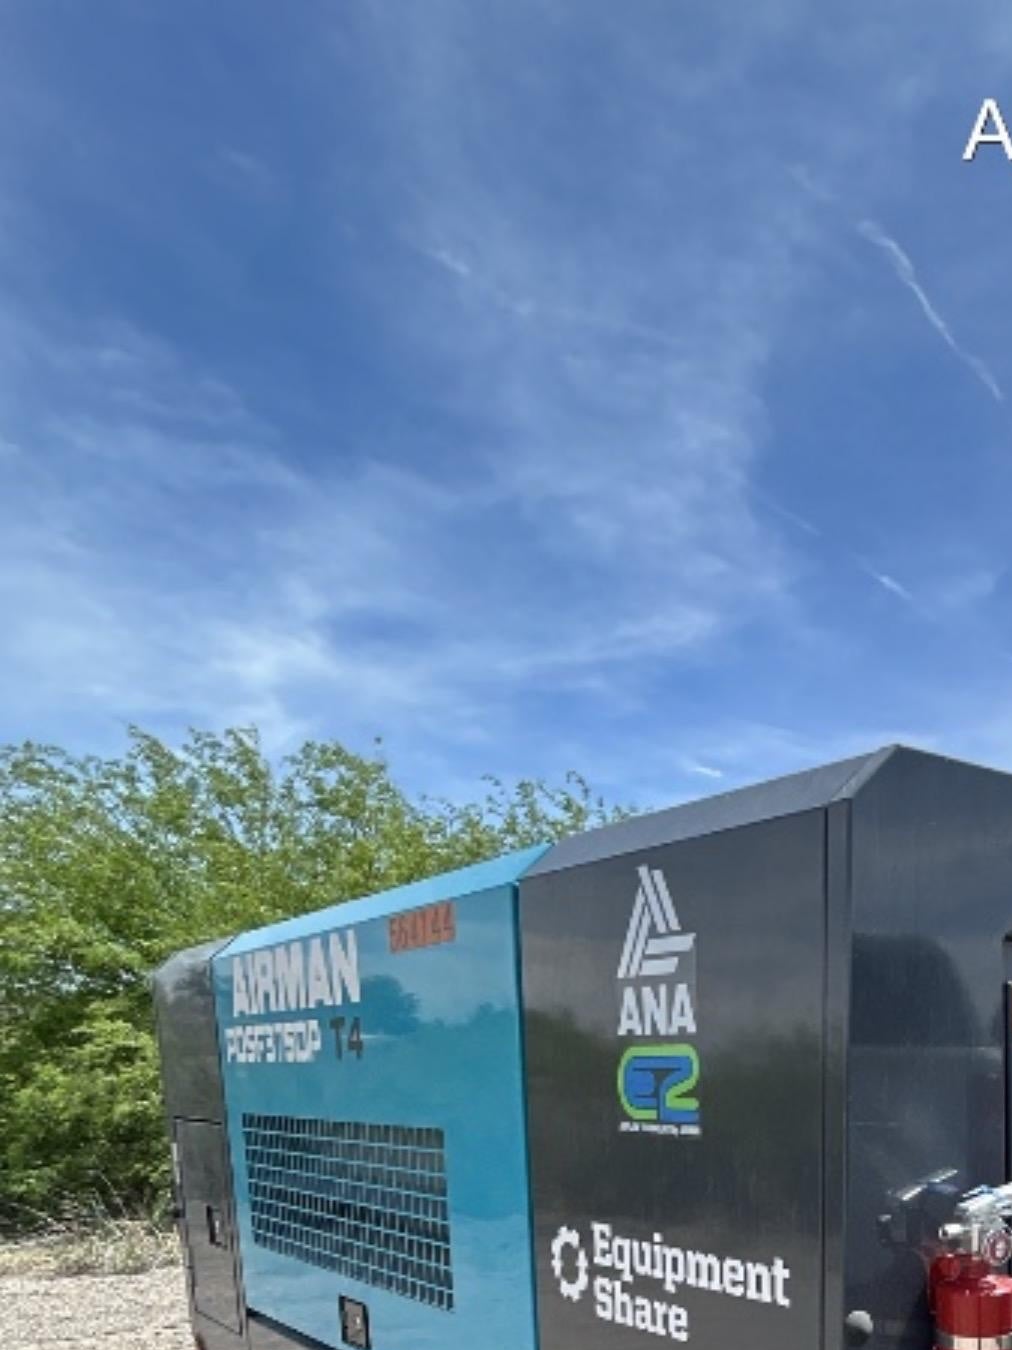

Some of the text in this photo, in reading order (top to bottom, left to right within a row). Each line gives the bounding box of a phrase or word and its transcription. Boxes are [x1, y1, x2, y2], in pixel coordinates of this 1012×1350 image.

[232, 929, 361, 1018] AIRMAN
[329, 1015, 364, 1062] T4
[616, 983, 697, 1036] ANA
[591, 1221, 791, 1308] Equipment
[593, 1275, 689, 1342] Share
